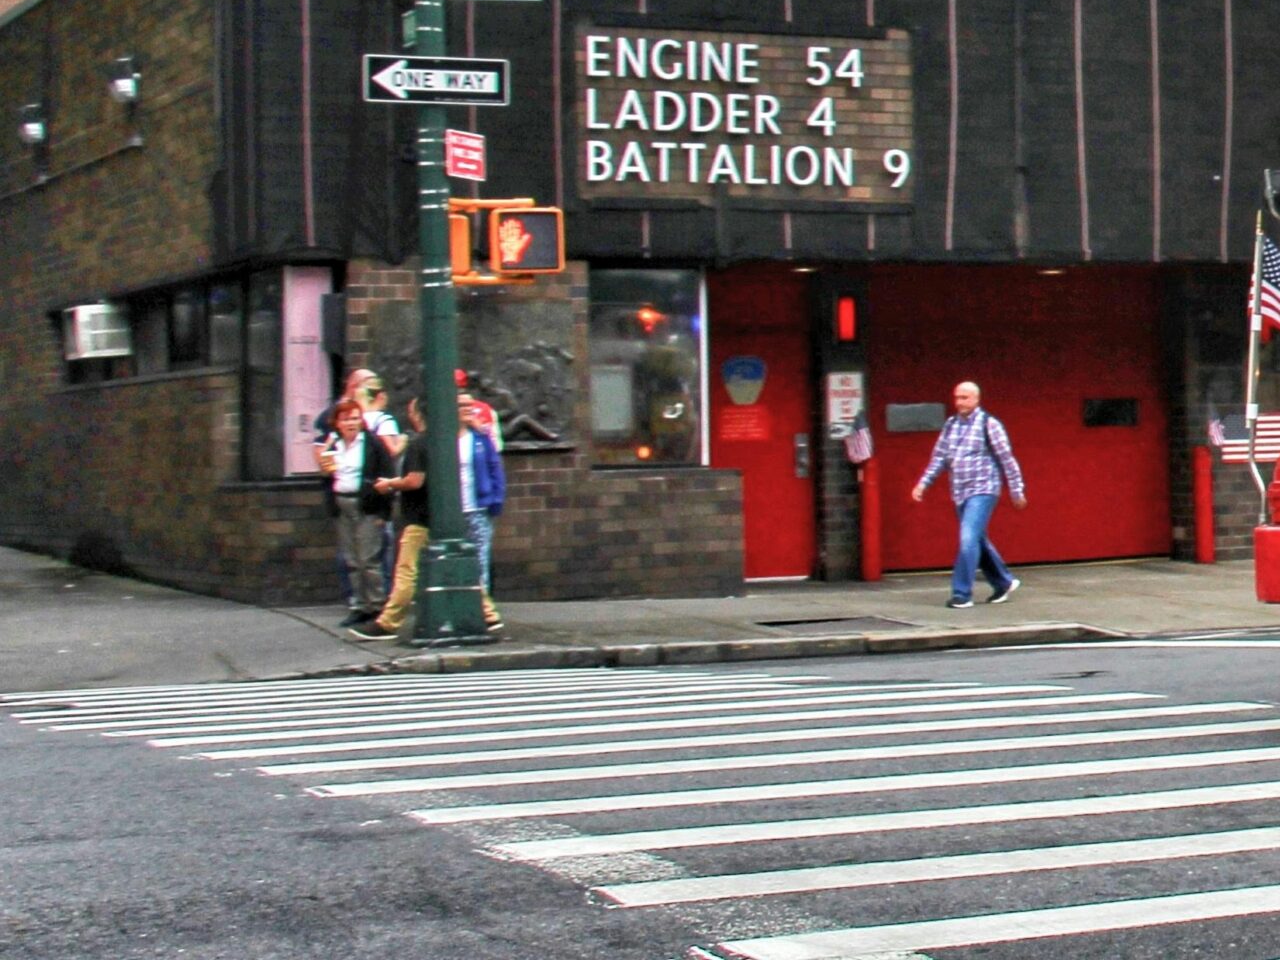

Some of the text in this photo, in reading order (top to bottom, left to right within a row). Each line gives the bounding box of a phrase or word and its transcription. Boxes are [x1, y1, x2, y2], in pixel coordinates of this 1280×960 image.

[391, 70, 488, 90] ONE WAY
[585, 35, 864, 88] ENGINE 54
[585, 88, 837, 137] LADDER 4
[585, 141, 911, 188] BATTALION 9
